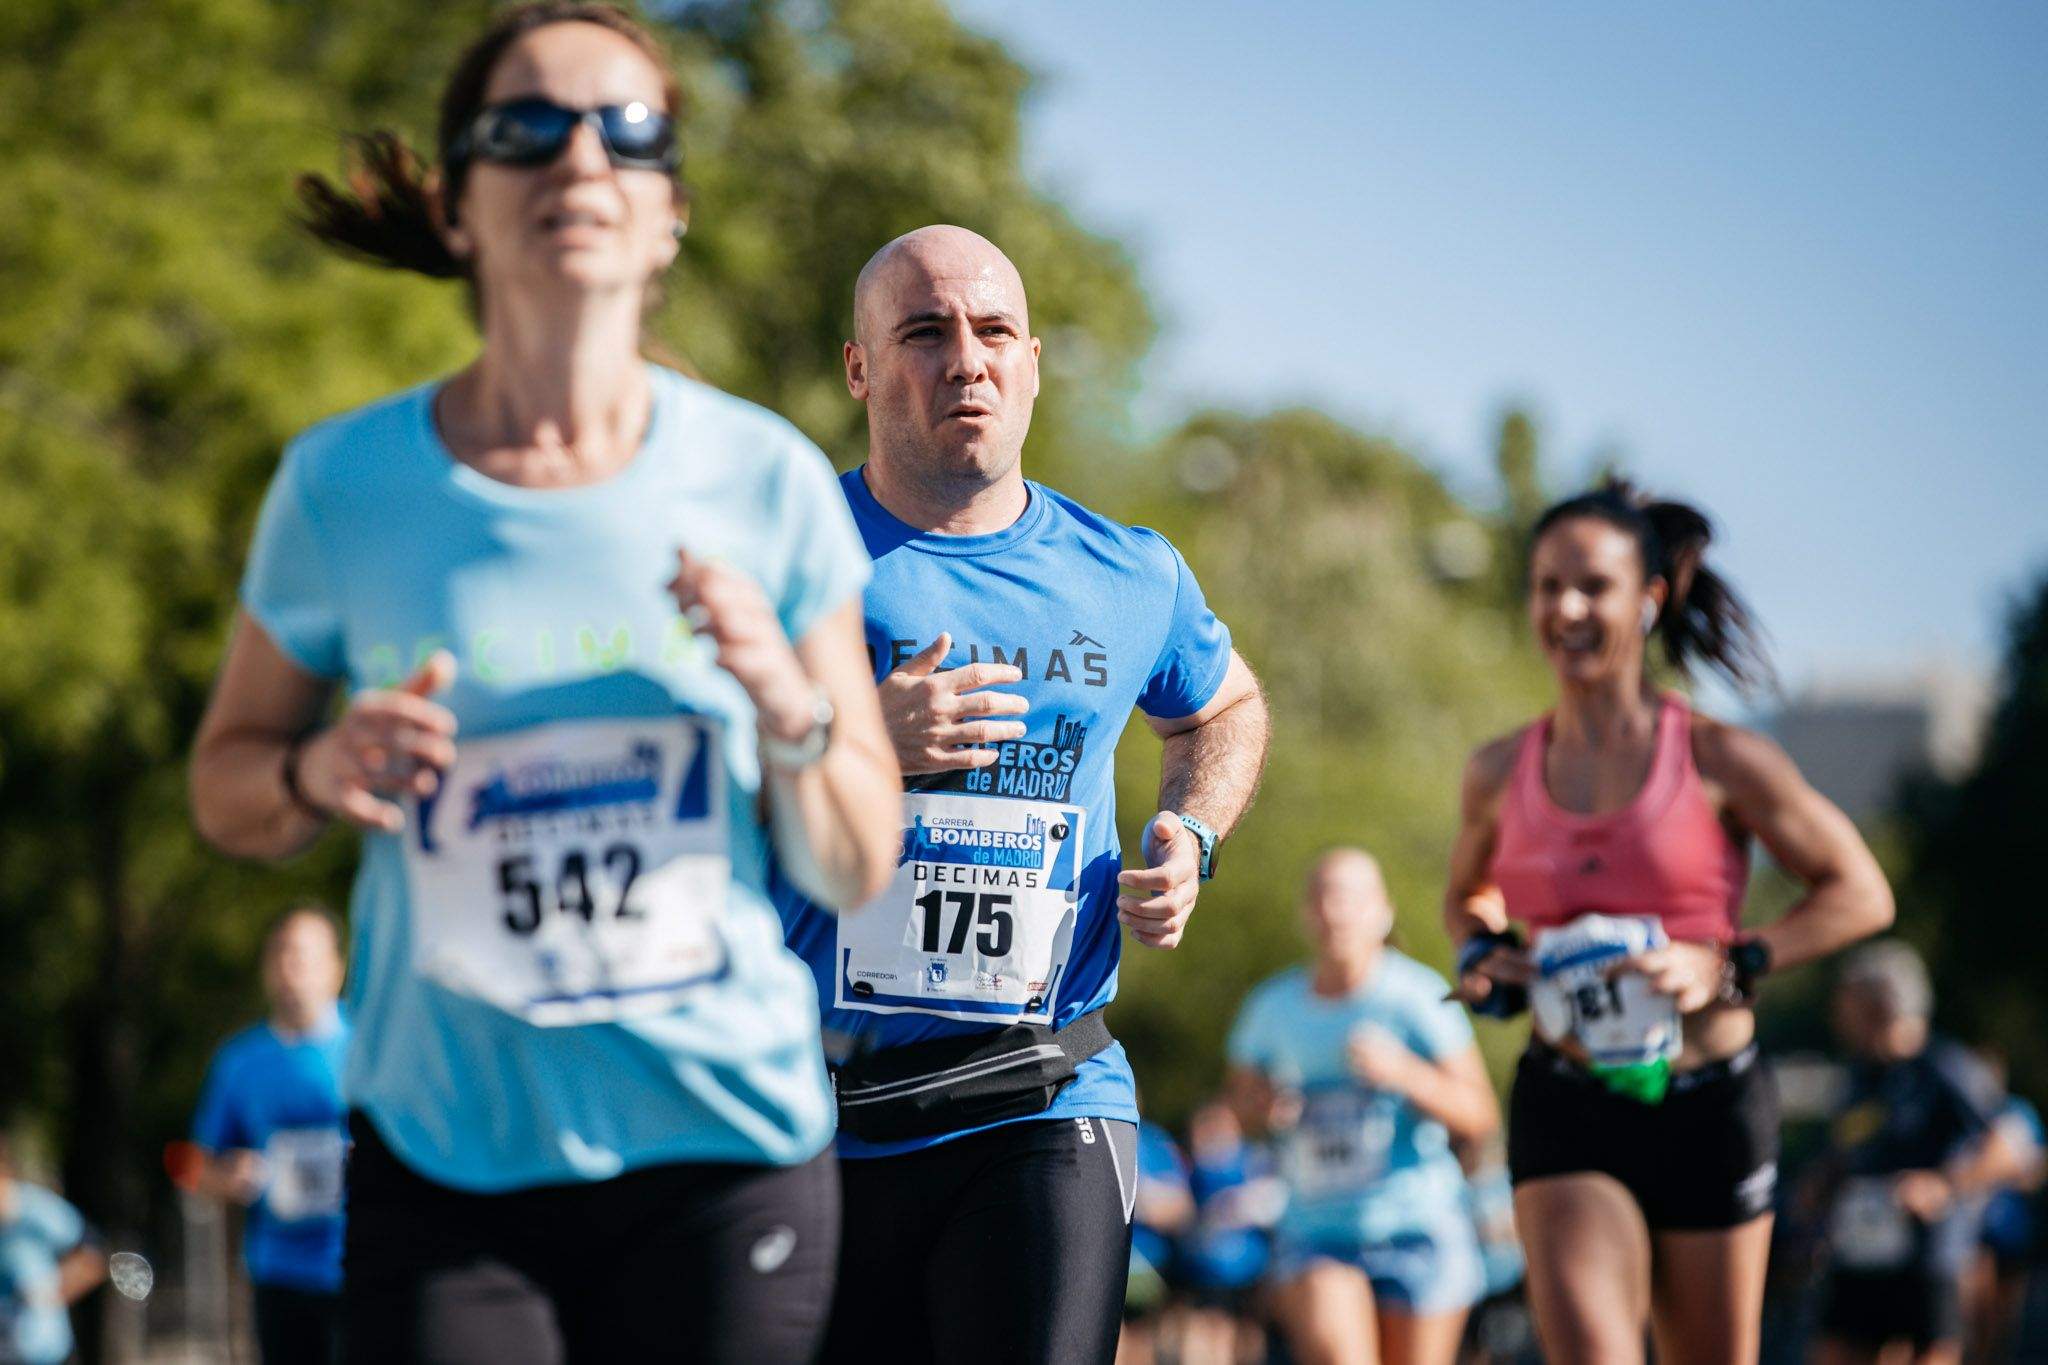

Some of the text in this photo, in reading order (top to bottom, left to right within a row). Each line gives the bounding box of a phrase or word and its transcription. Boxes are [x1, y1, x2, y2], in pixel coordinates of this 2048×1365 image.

[967, 768, 992, 791] de
[932, 818, 975, 827] CARRERA
[929, 828, 1042, 850] BOMBEROS
[973, 847, 1042, 867] de MADRID
[913, 865, 1038, 888] DECIMAS
[497, 844, 646, 937] 542
[915, 889, 1013, 958] 175
